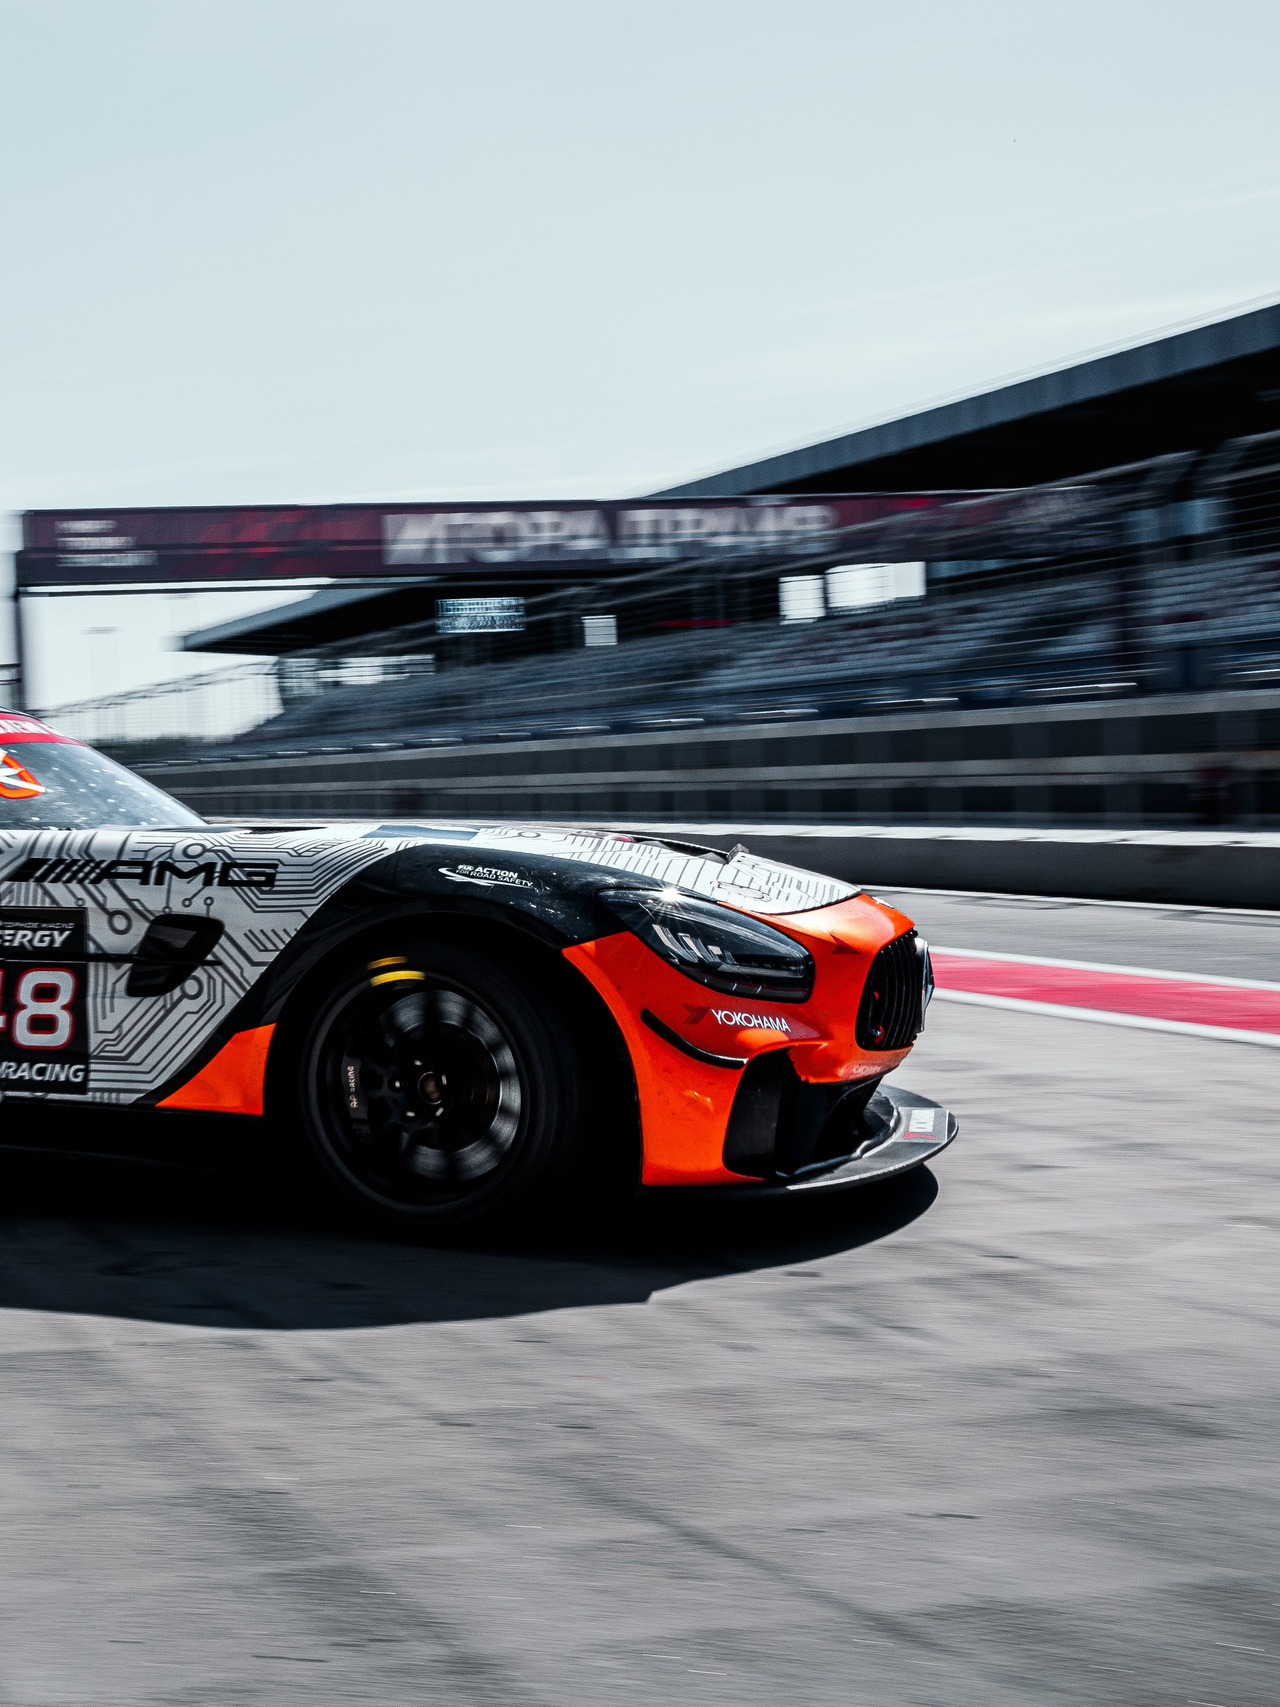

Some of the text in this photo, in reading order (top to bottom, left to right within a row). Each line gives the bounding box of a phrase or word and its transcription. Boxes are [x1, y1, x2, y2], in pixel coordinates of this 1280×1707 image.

[469, 870, 497, 880] ROAD
[497, 875, 534, 888] SAFETY
[474, 866, 519, 879] ACTION
[710, 1008, 793, 1033] YOKOHAMA
